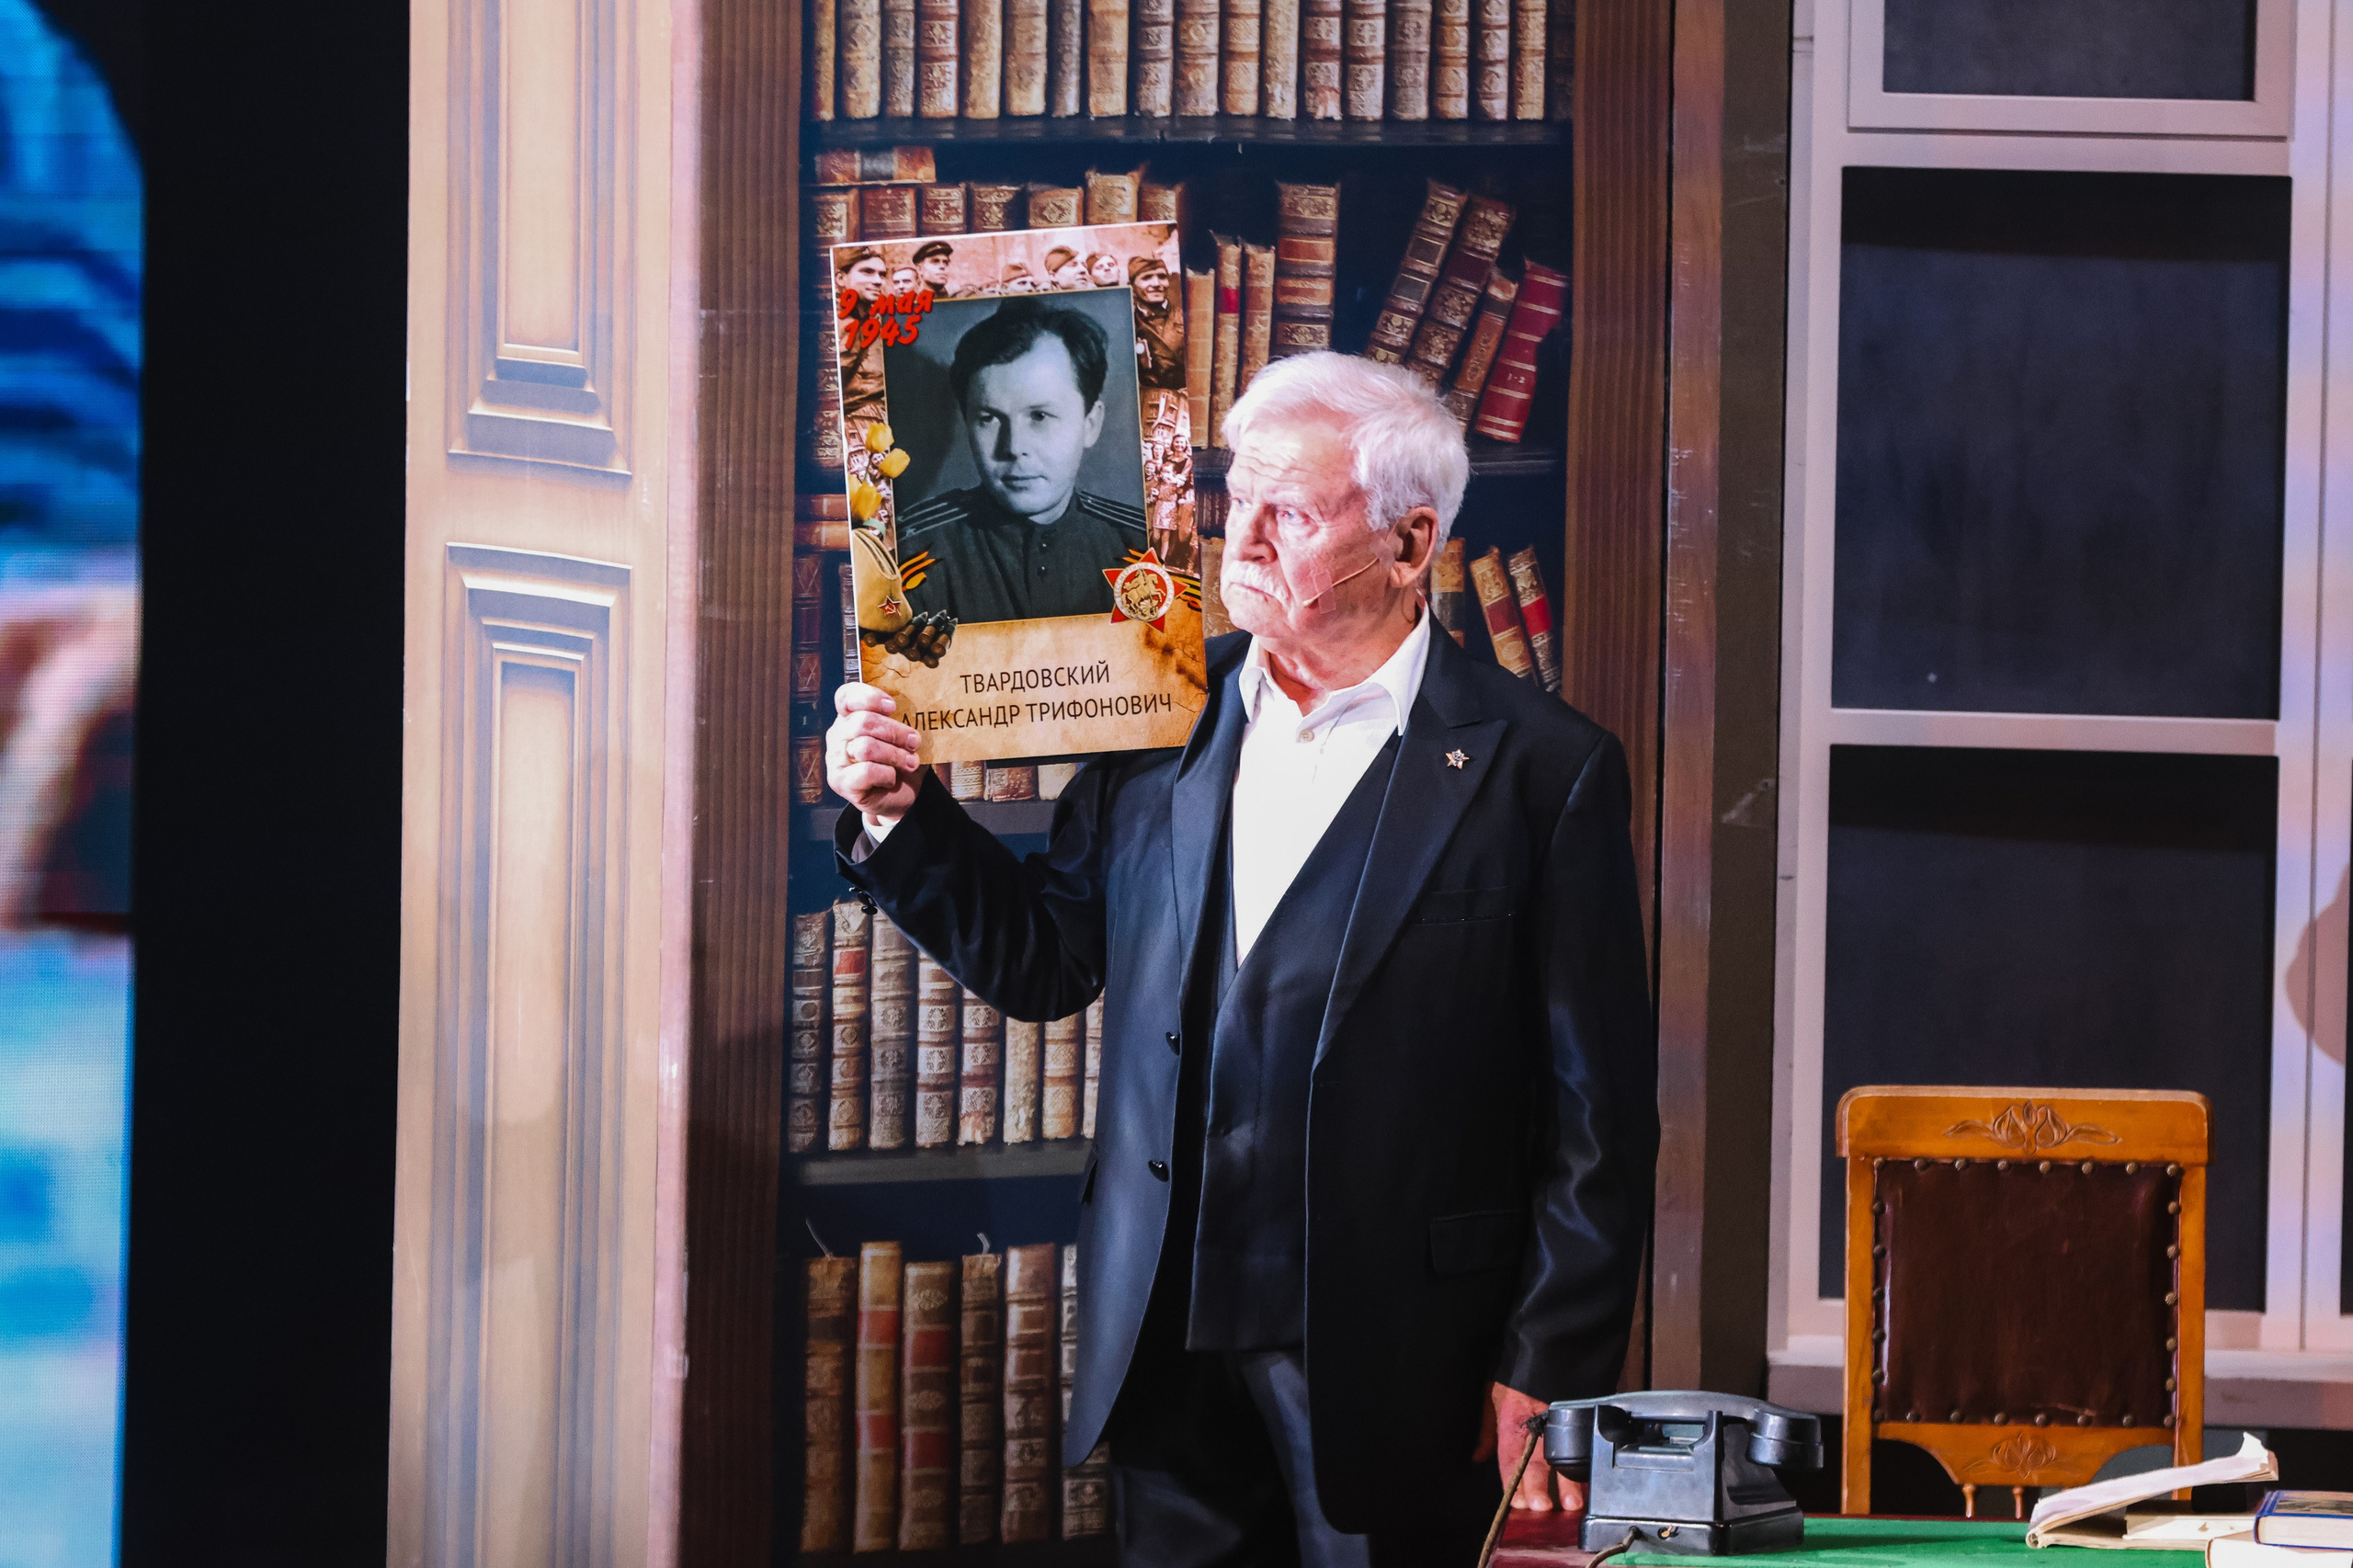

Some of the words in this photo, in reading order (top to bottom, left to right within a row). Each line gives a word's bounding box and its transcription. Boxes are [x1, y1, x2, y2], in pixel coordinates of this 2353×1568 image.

[837, 288, 858, 320] 9
[868, 289, 935, 316] мая
[844, 313, 923, 349] 1945
[959, 659, 1110, 694] ТВАРДОВСКИЙ
[1025, 692, 1172, 723] ТРИФОНОВИЧ
